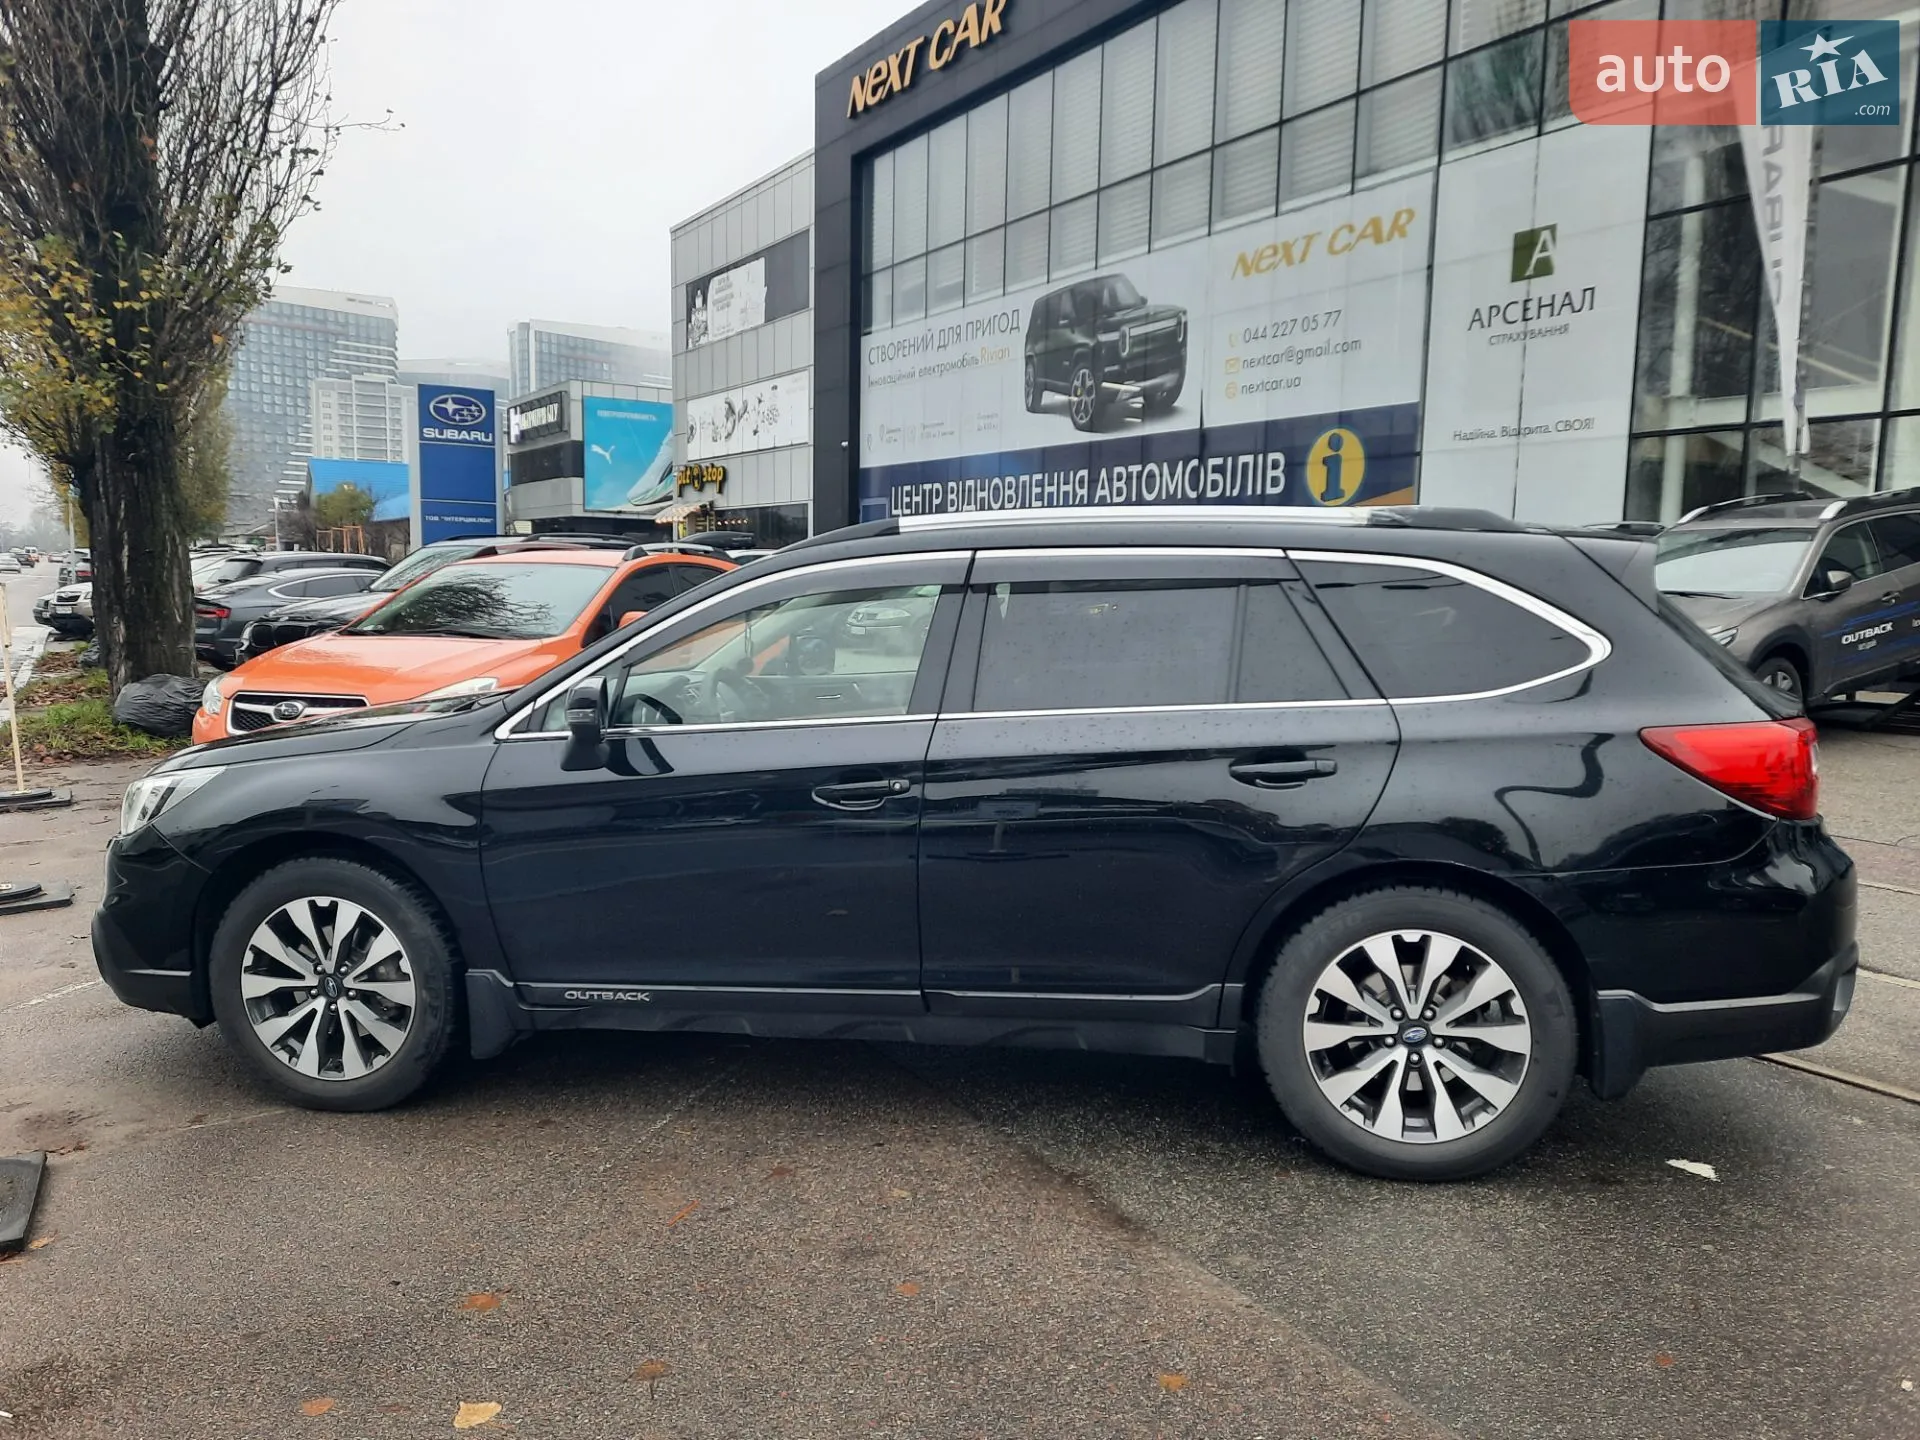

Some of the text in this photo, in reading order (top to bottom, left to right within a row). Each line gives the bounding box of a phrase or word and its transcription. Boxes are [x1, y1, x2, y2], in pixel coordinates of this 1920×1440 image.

[928, 0, 1007, 71] CAR
[1326, 207, 1416, 256] CAR
[1467, 285, 1597, 331] АРСЕНАЛ
[868, 308, 1020, 366] СТВОРЕНИЙ ДЛЯ ПРИГОД
[1243, 309, 1343, 344] 044 227 05 77
[1242, 338, 1362, 369] nextcar@gmail.com
[1241, 376, 1301, 395] nextcar.ua
[422, 427, 493, 442] SUBARU
[1555, 417, 1595, 433] СВОЯ!
[702, 464, 725, 493] stop
[891, 451, 1286, 516] ЦЕНТР ВІДНОВЛЕННЯ АВТОМОБІЛІВ
[1841, 622, 1894, 645] OUTBACK
[564, 990, 650, 1002] OUTBACK
